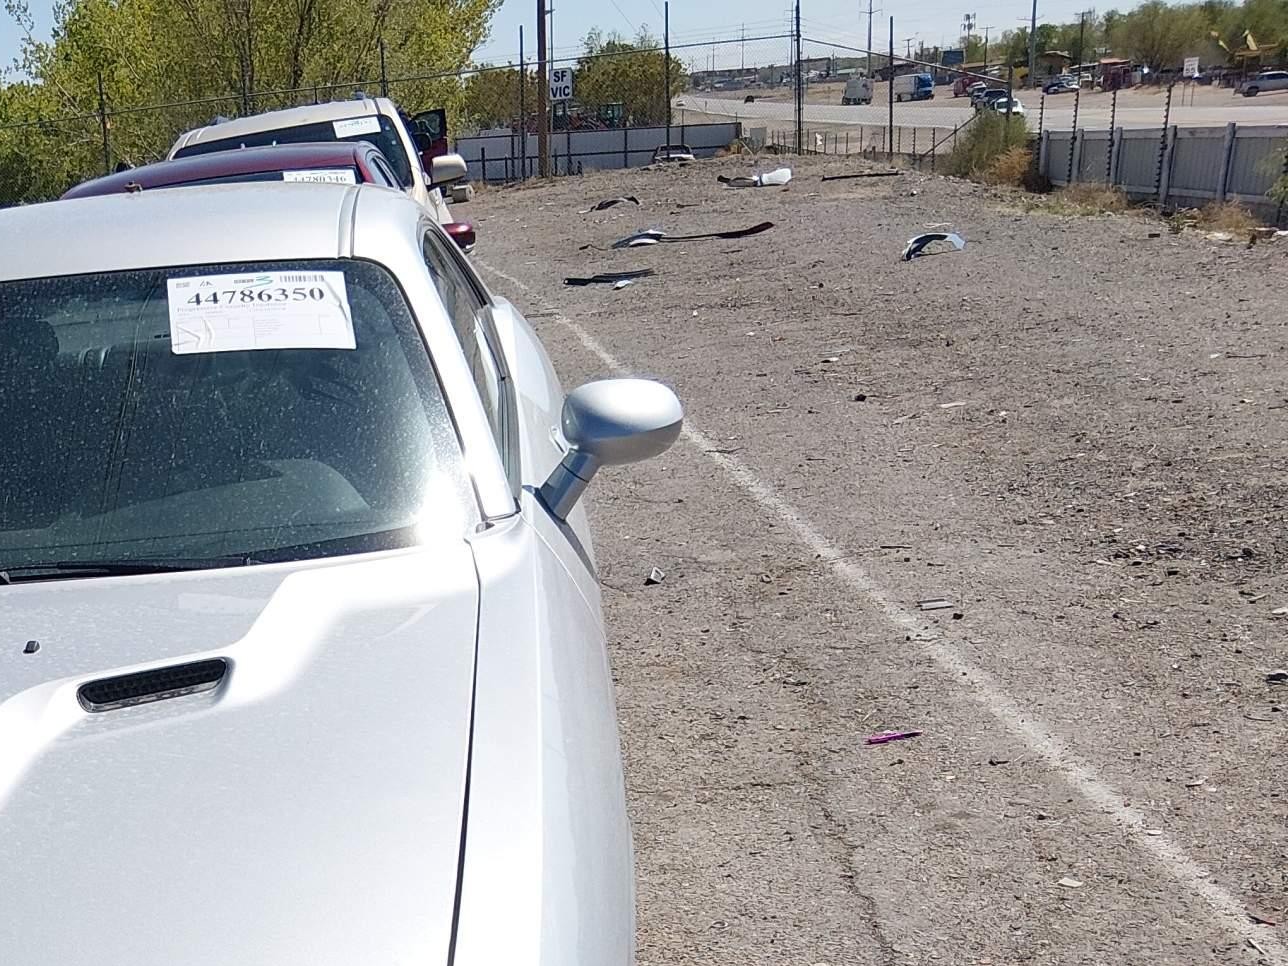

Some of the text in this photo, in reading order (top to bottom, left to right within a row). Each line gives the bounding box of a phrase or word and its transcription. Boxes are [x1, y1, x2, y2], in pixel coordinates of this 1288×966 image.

[553, 70, 567, 83] SF
[550, 85, 570, 98] VIC
[187, 287, 325, 306] 44786350
